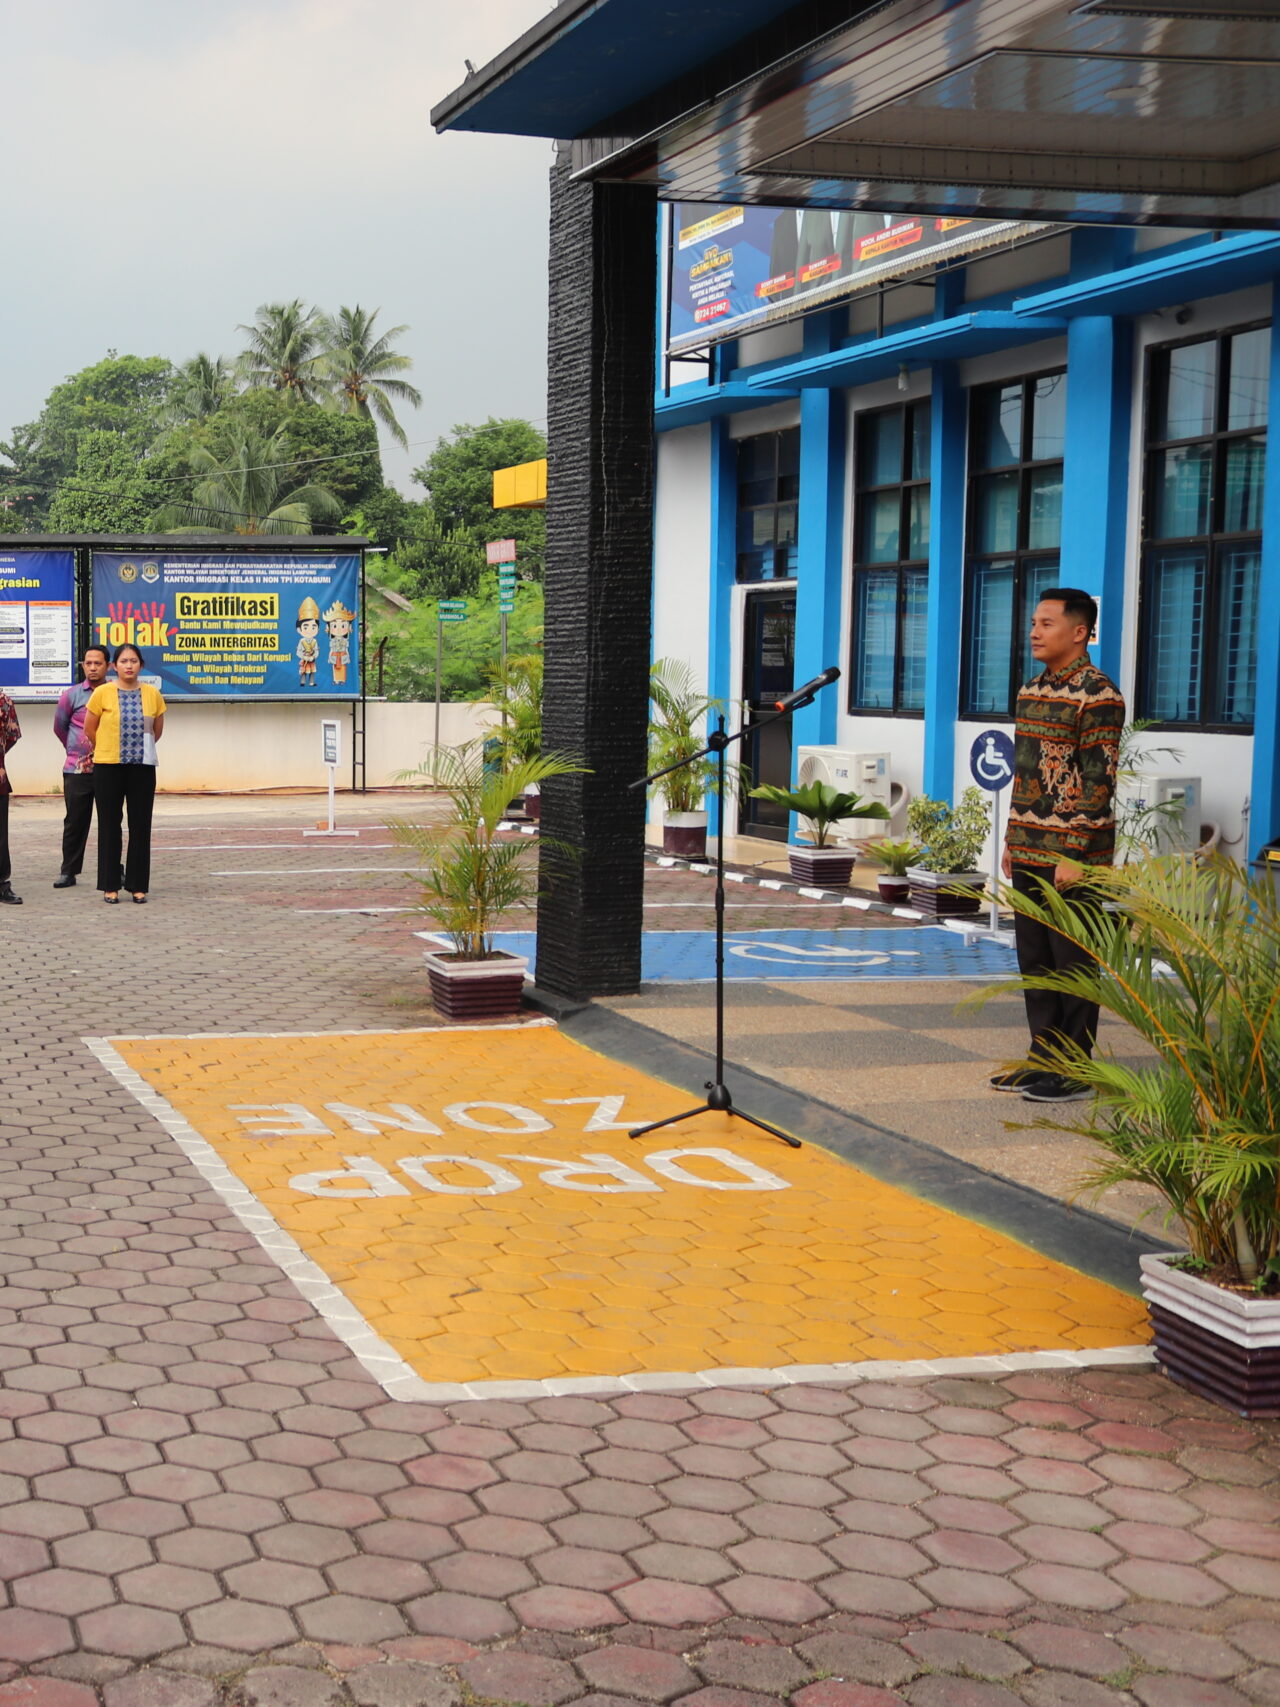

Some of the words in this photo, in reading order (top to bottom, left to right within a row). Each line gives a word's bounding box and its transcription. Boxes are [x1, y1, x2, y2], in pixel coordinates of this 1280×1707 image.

[164, 575, 195, 583] KANTOR
[195, 575, 229, 583] IMIGRASI
[230, 575, 254, 583] KELAS
[255, 575, 261, 583] II
[180, 595, 275, 616] Gratifikasi
[180, 620, 201, 630] Bantu
[202, 620, 222, 630] Kami
[95, 617, 170, 647] Tolak
[178, 637, 206, 648] ZONA
[209, 637, 276, 648] INTERGRITAS
[163, 653, 191, 662] Menuju
[192, 653, 222, 662] Wilayah
[223, 653, 245, 662] Bebas
[246, 653, 262, 662] Dari
[263, 653, 292, 662] Korupsi
[186, 664, 201, 673] Dan
[203, 664, 233, 673] Wilayah
[233, 664, 267, 673] Birokrasi
[189, 676, 213, 685] Bersih
[214, 676, 229, 685] Dan
[230, 676, 264, 685] Melayani
[227, 1095, 676, 1136] ZONE
[287, 1146, 793, 1199] DROP
